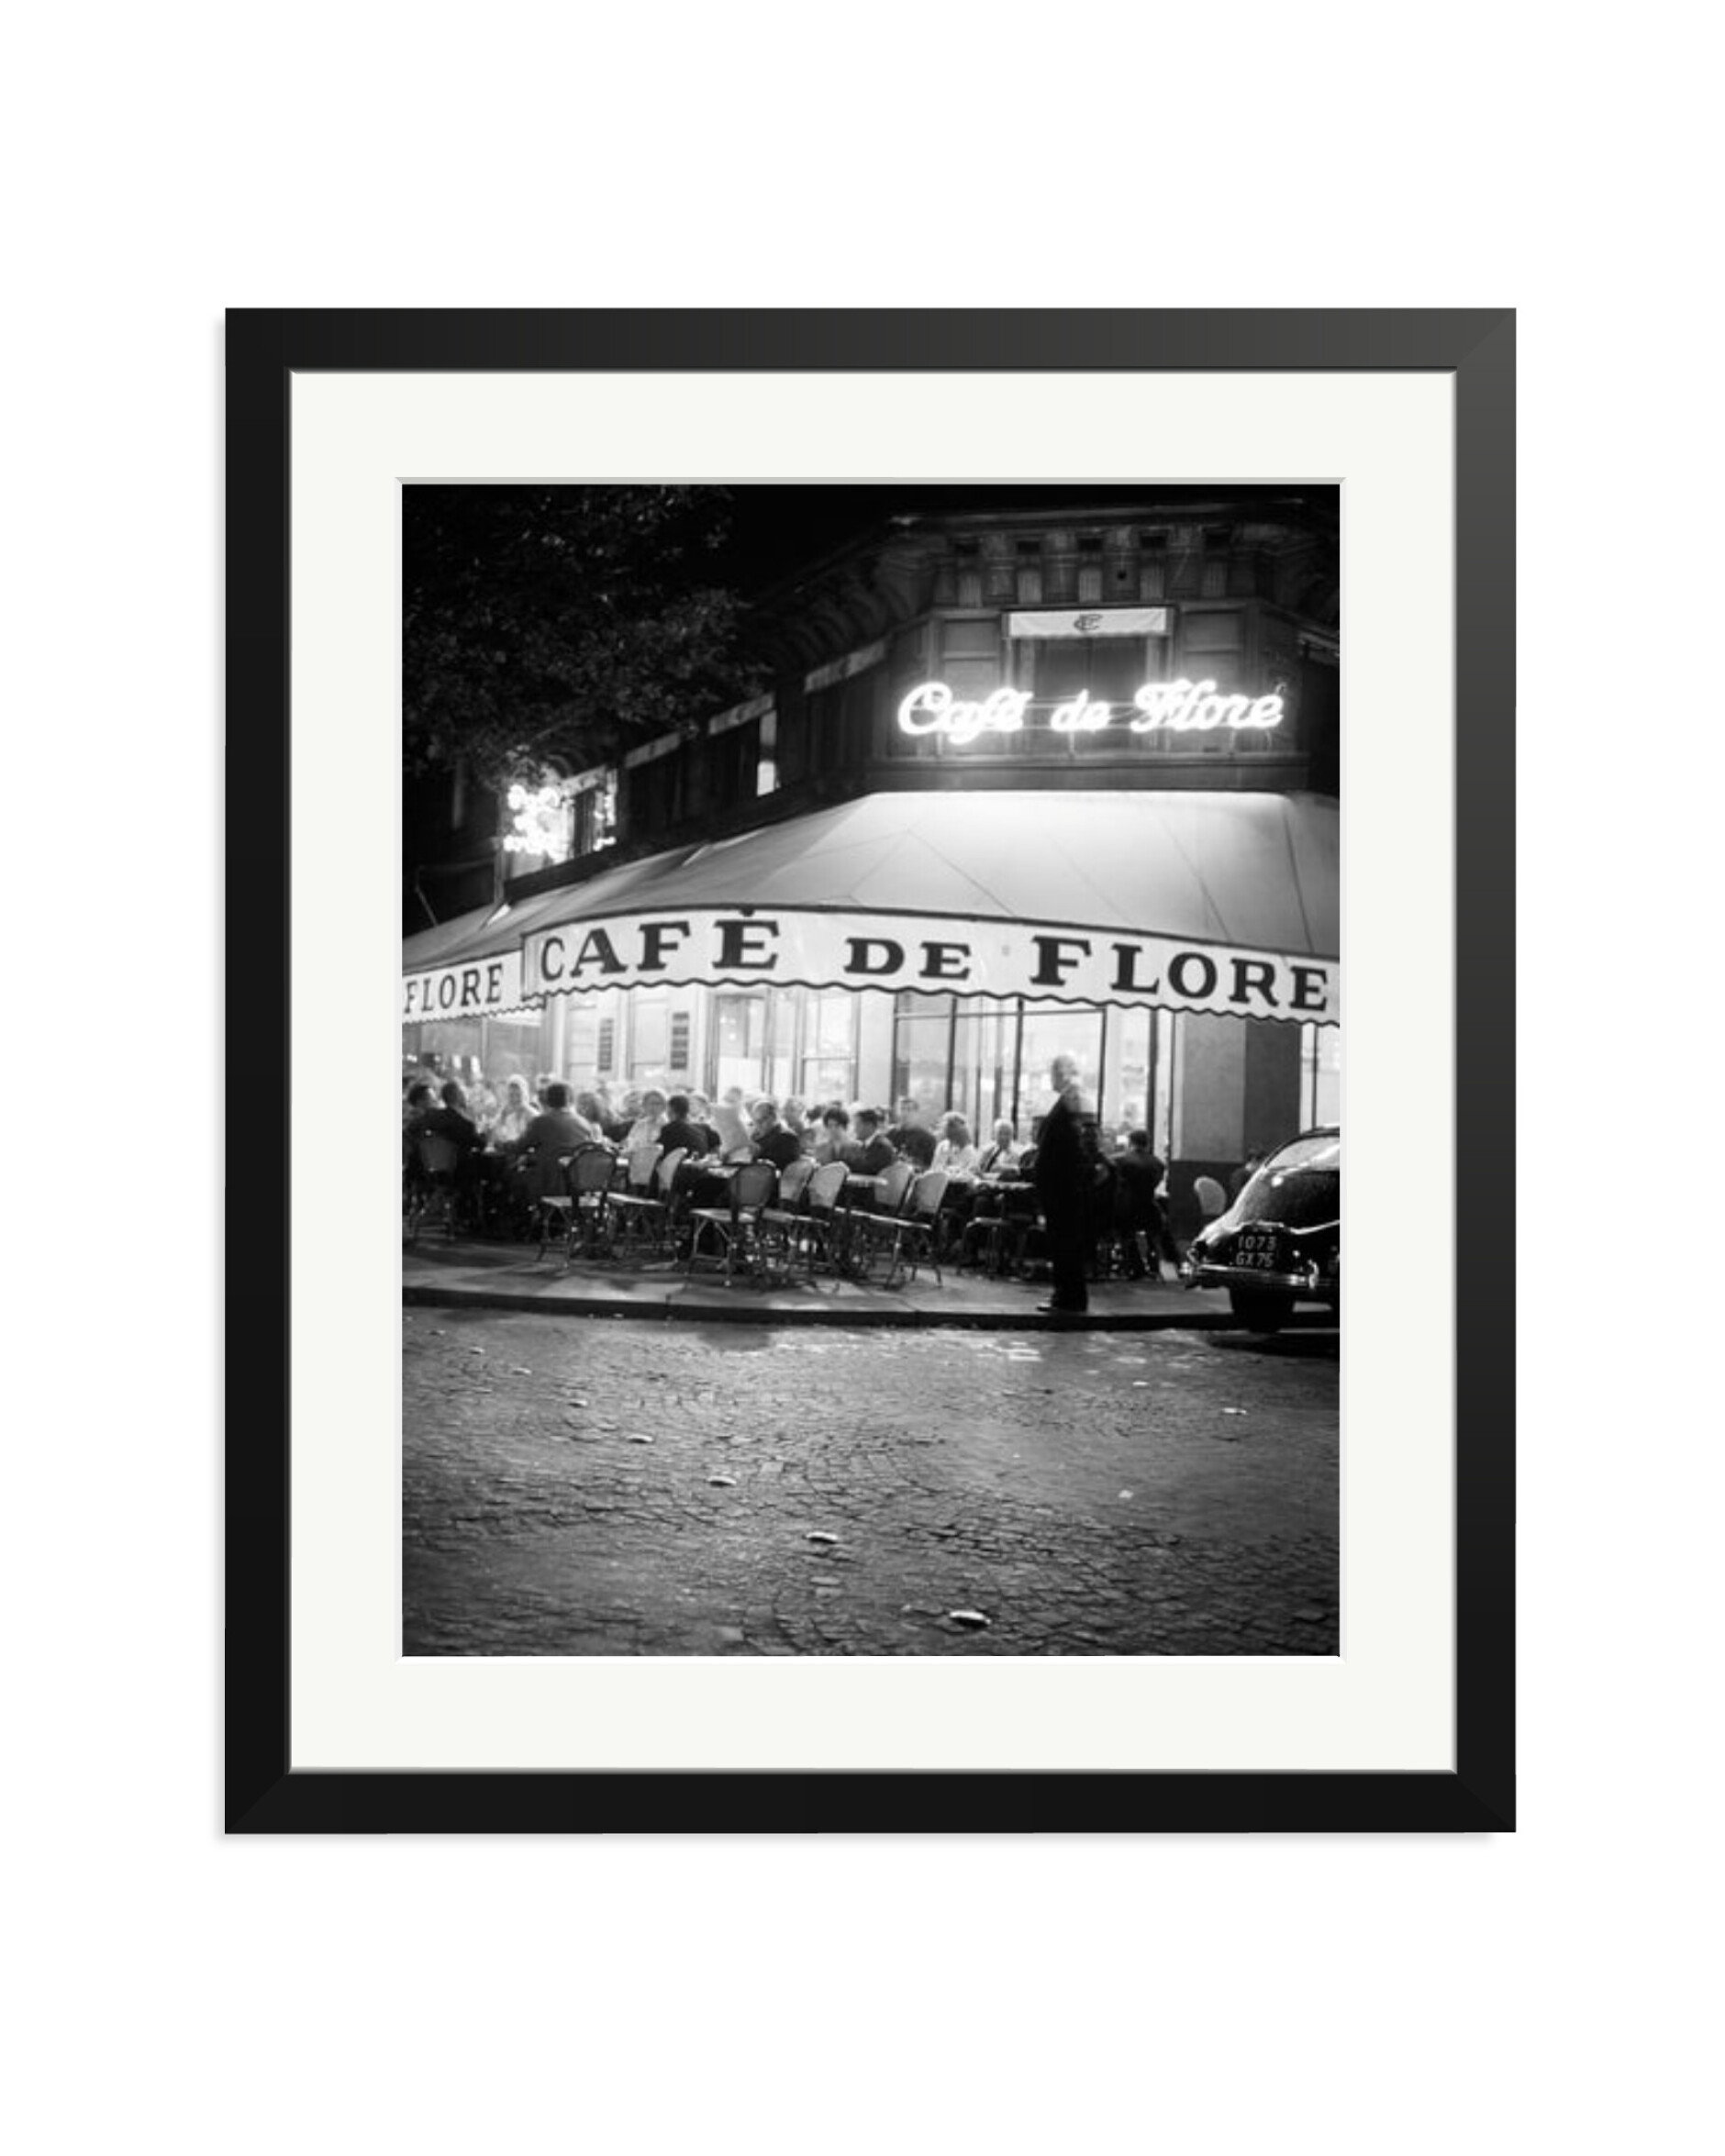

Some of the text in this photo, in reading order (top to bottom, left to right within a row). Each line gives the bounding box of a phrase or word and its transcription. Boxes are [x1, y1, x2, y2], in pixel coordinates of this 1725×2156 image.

[1052, 690, 1111, 732] de
[1131, 679, 1284, 732] Flore
[404, 963, 503, 1014] FLORE
[844, 938, 972, 980] DE
[1029, 936, 1329, 1011] FLORE
[1238, 1235, 1277, 1251] 1073
